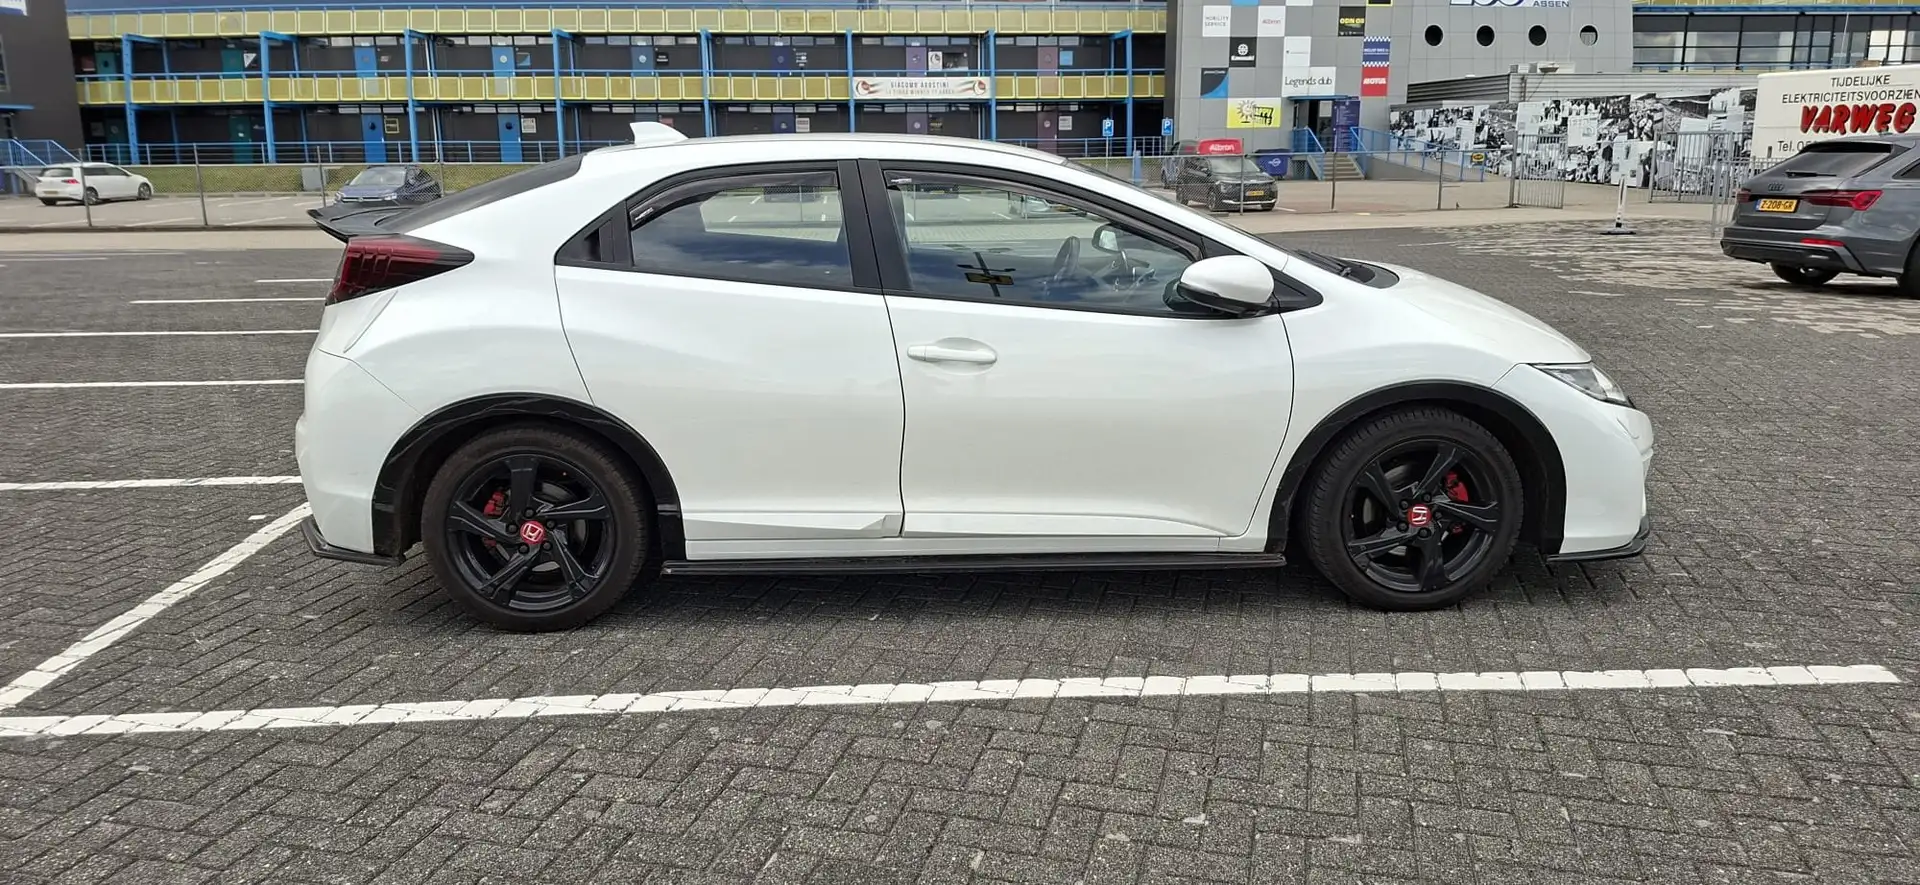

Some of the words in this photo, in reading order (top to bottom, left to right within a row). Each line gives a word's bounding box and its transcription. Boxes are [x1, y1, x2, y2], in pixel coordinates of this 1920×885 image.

[1532, 0, 1570, 8] ASSEN
[1284, 76, 1317, 88] Legends
[1831, 75, 1891, 87] TIJDELIJKE
[1164, 120, 1170, 129] P
[1800, 102, 1918, 135] VARWEG
[1105, 121, 1111, 130] P
[1777, 140, 1795, 152] Tel.
